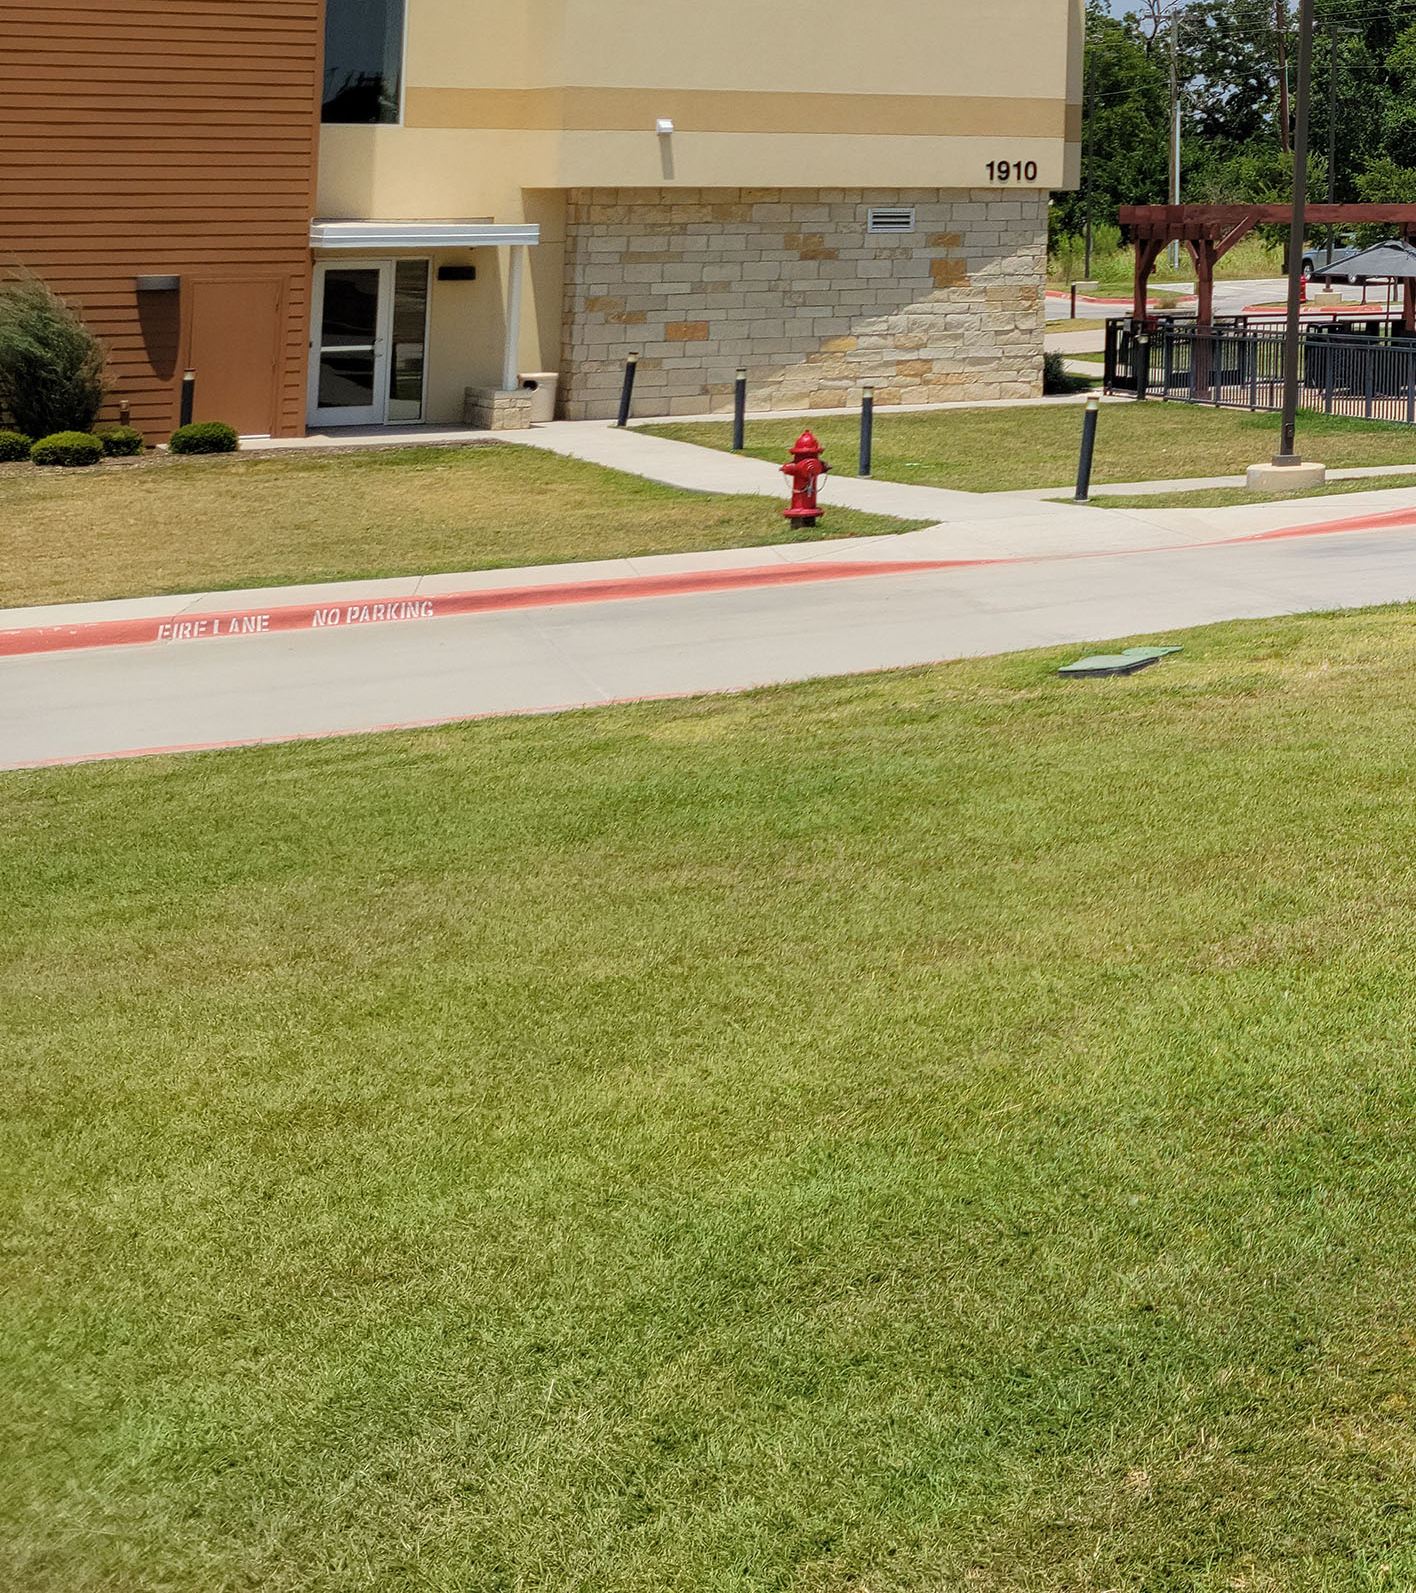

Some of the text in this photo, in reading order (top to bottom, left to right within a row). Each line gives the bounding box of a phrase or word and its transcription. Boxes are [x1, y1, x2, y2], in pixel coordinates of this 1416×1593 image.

[986, 160, 1038, 182] 1910
[157, 600, 434, 641] FIRE LANE NO PARKING
